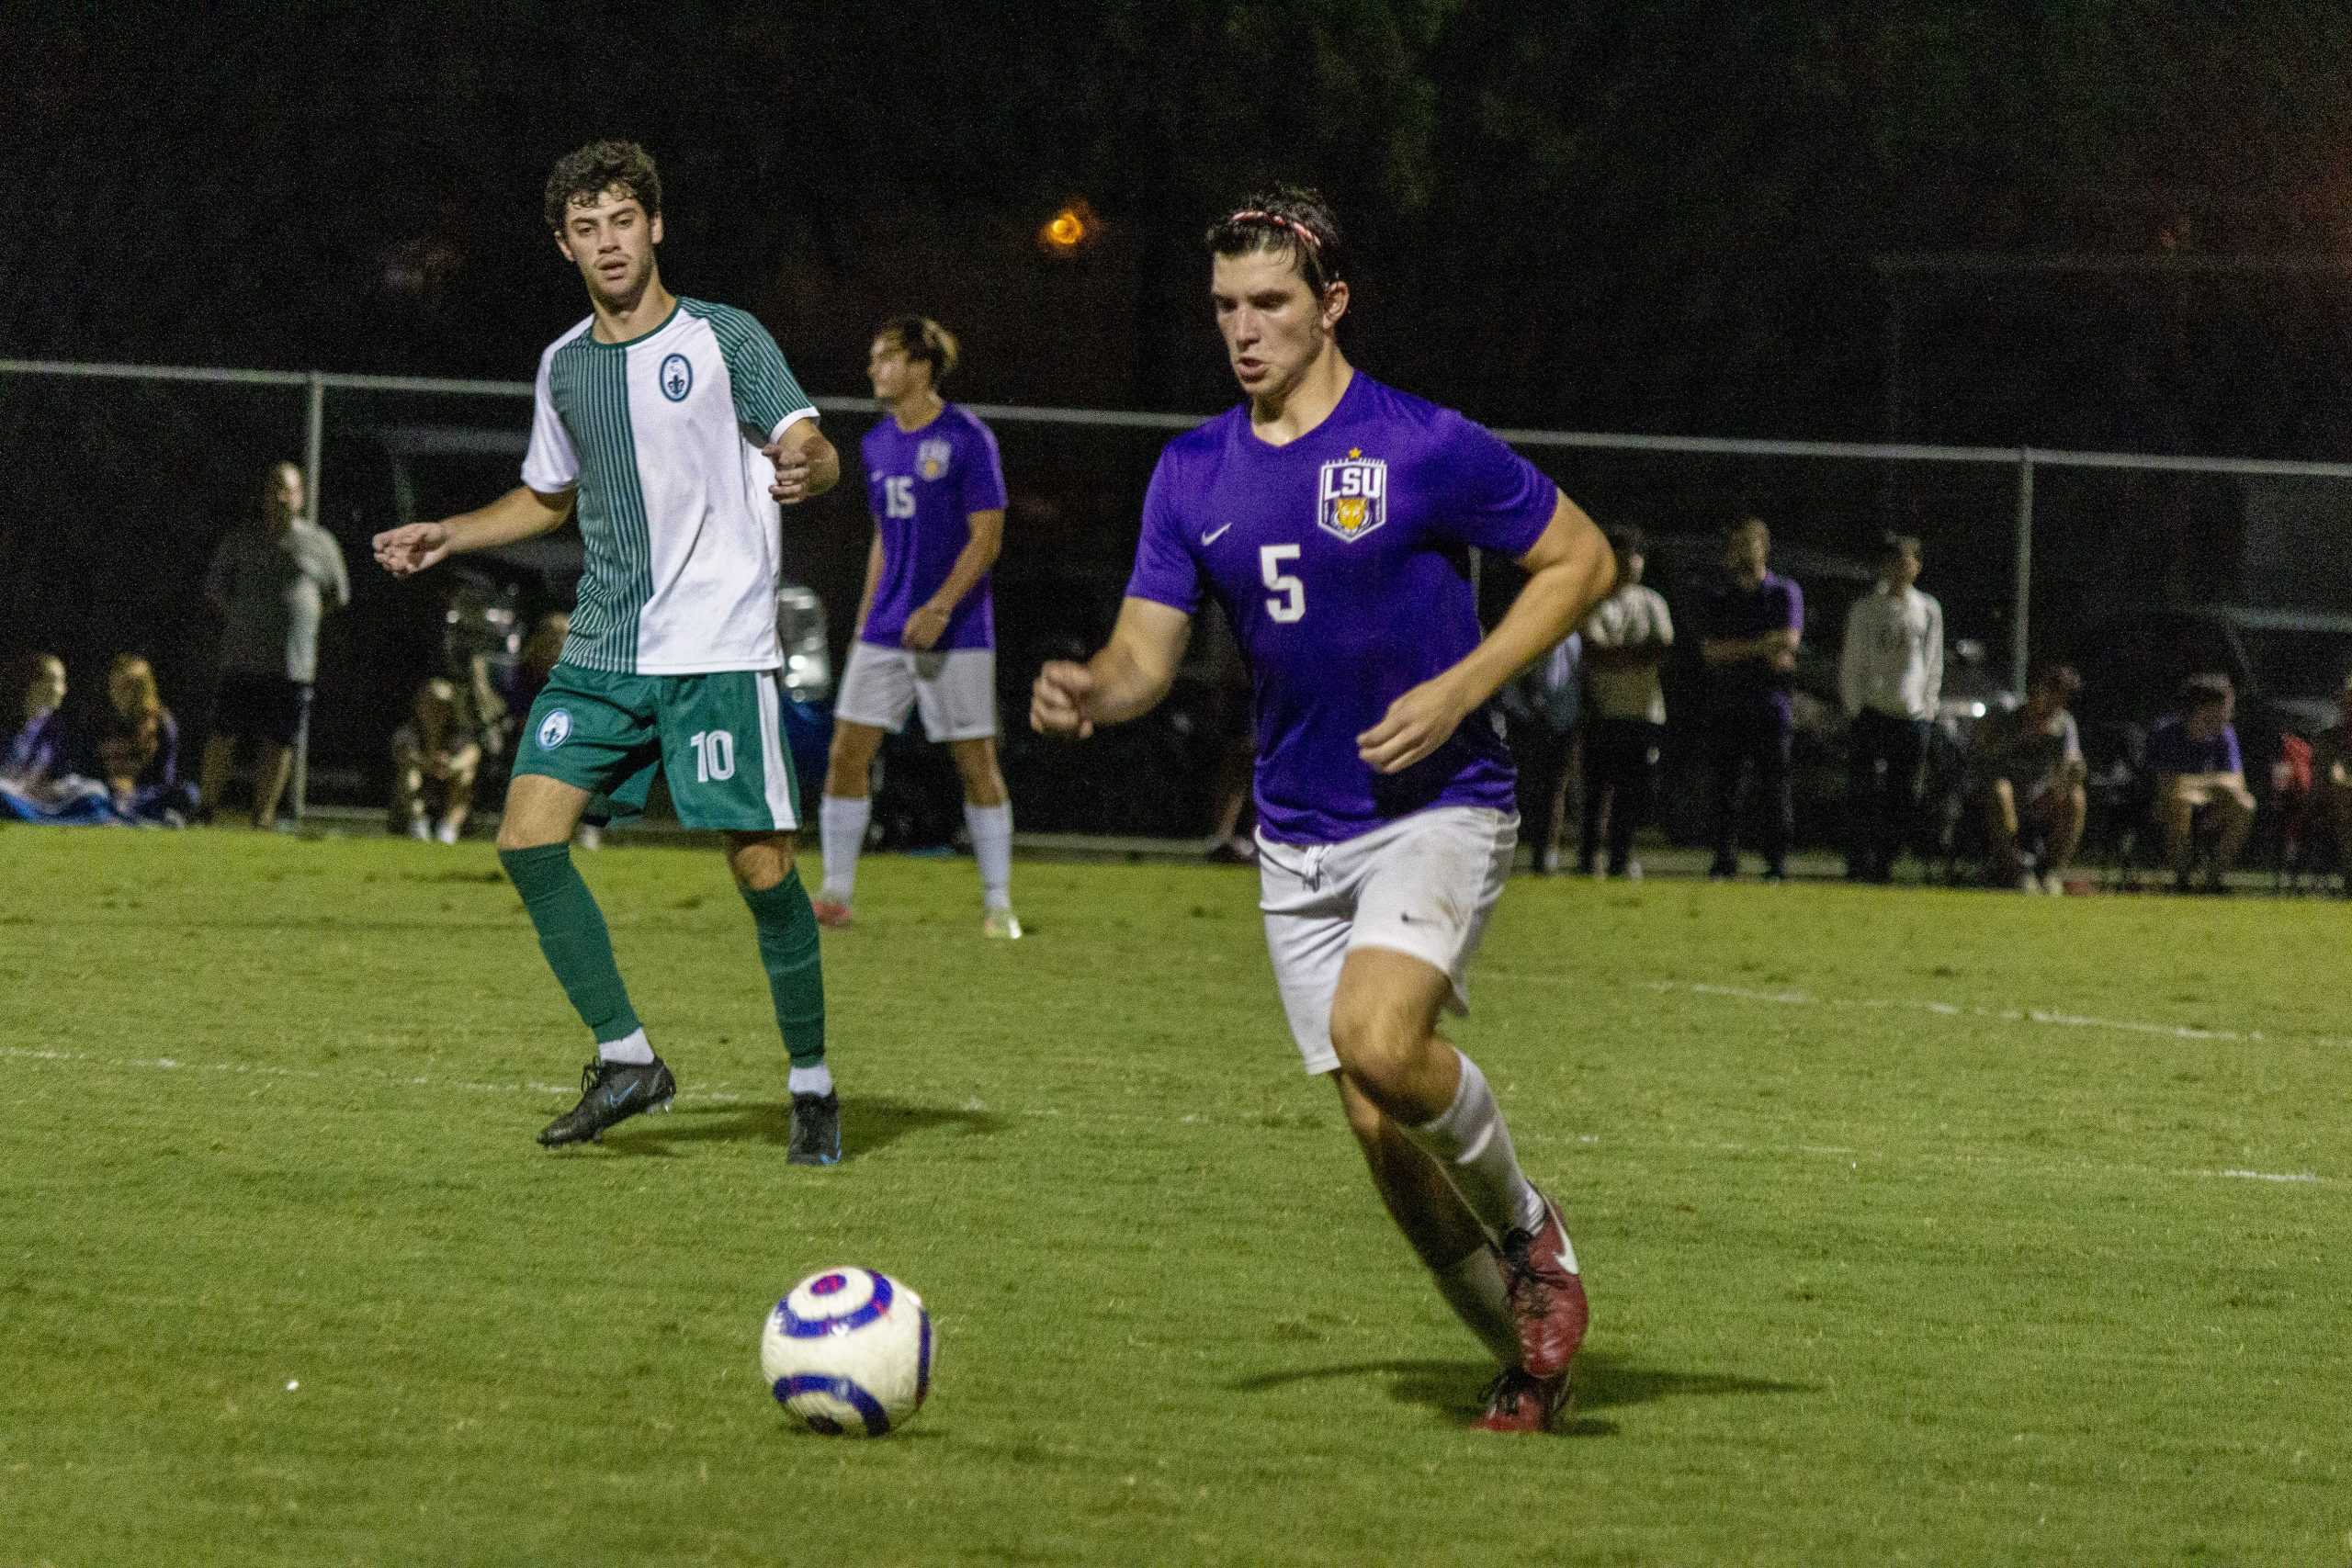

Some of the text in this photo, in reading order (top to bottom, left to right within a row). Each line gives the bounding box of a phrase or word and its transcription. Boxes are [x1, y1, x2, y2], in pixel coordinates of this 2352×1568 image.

[885, 476, 916, 519] 15
[1324, 467, 1382, 501] LSU
[1260, 544, 1306, 623] 5
[691, 729, 734, 783] 10
